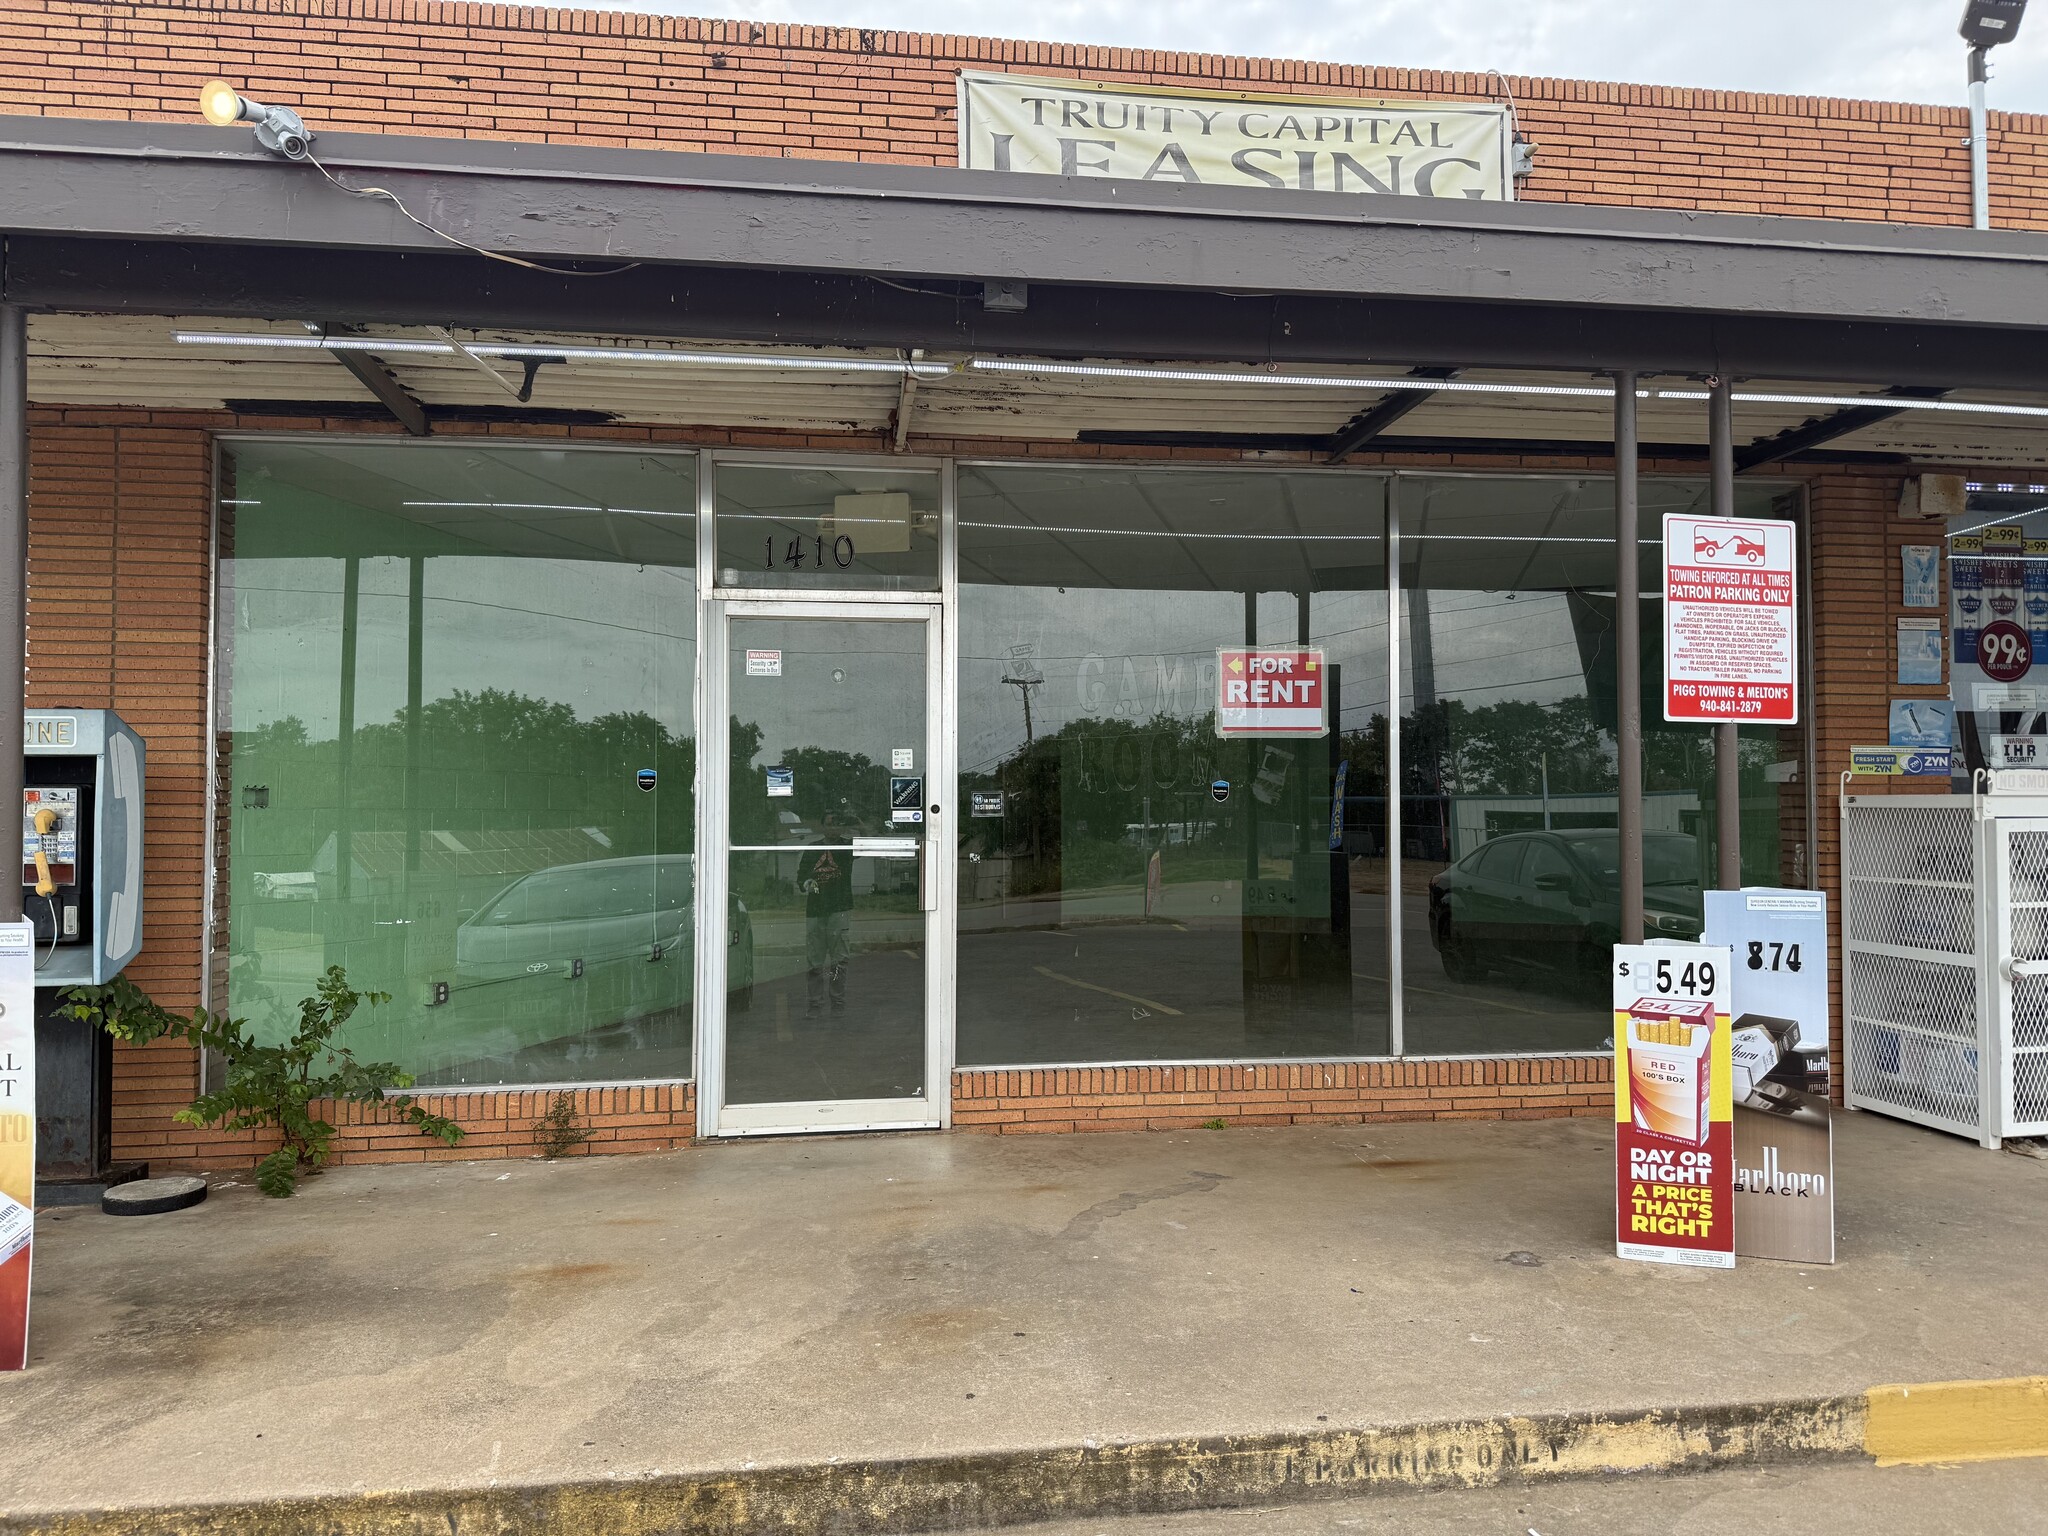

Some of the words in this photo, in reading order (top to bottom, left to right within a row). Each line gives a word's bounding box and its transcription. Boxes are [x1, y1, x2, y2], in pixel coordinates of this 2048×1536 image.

[1020, 98, 1225, 136] TRUITY
[1238, 112, 1454, 149] CAPITAL
[1954, 538, 1960, 548] 2
[1985, 529, 1992, 540] 2
[2000, 529, 2019, 541] 99¢
[764, 533, 855, 570] 1410
[2034, 541, 2048, 551] 99
[1670, 569, 1700, 582] TOWING
[1702, 571, 1740, 584] ENFORCED
[1742, 573, 1750, 585] AT
[1752, 574, 1766, 586] ALL
[1767, 574, 1790, 587] TIMES
[1670, 585, 1712, 599] PATRON
[1714, 587, 1760, 601] PARKING
[1763, 588, 1789, 603] ONLY
[1983, 633, 2027, 664] 99¢
[1249, 657, 1293, 675] FOR
[1226, 679, 1316, 704] RENT
[1673, 684, 1696, 696] PIGG
[1698, 685, 1735, 697] TOWING
[1738, 686, 1744, 698] &
[1747, 687, 1788, 699] MELTON'S
[1700, 700, 1761, 712] 940-841-2879
[24, 722, 71, 743] ONE
[1874, 765, 1892, 773] ZYN
[1924, 756, 1948, 767] ZYN
[2000, 774, 2016, 788] NO
[2019, 774, 2048, 788] SMO
[893, 780, 919, 805] WARNING
[1729, 944, 1734, 952] $
[1747, 941, 1802, 972] 8.74
[1618, 961, 1630, 978] $
[1656, 959, 1716, 996] 5.49
[1651, 1061, 1676, 1071] RED
[1806, 1056, 1829, 1072] Marlb
[1642, 1071, 1664, 1081] 100'S
[1666, 1075, 1685, 1084] BOX
[1643, 1130, 1659, 1138] CLASS
[1664, 1135, 1696, 1147] CIGARETTES
[1630, 1147, 1675, 1165] DAY
[1679, 1151, 1712, 1167] OR
[1630, 1162, 1712, 1185] NIGHT
[1631, 1183, 1651, 1198] A
[1653, 1184, 1713, 1203] PRICE
[1733, 1183, 1809, 1198] BLACK
[1631, 1198, 1713, 1220] THAT'S
[1631, 1214, 1713, 1238] RIGHT
